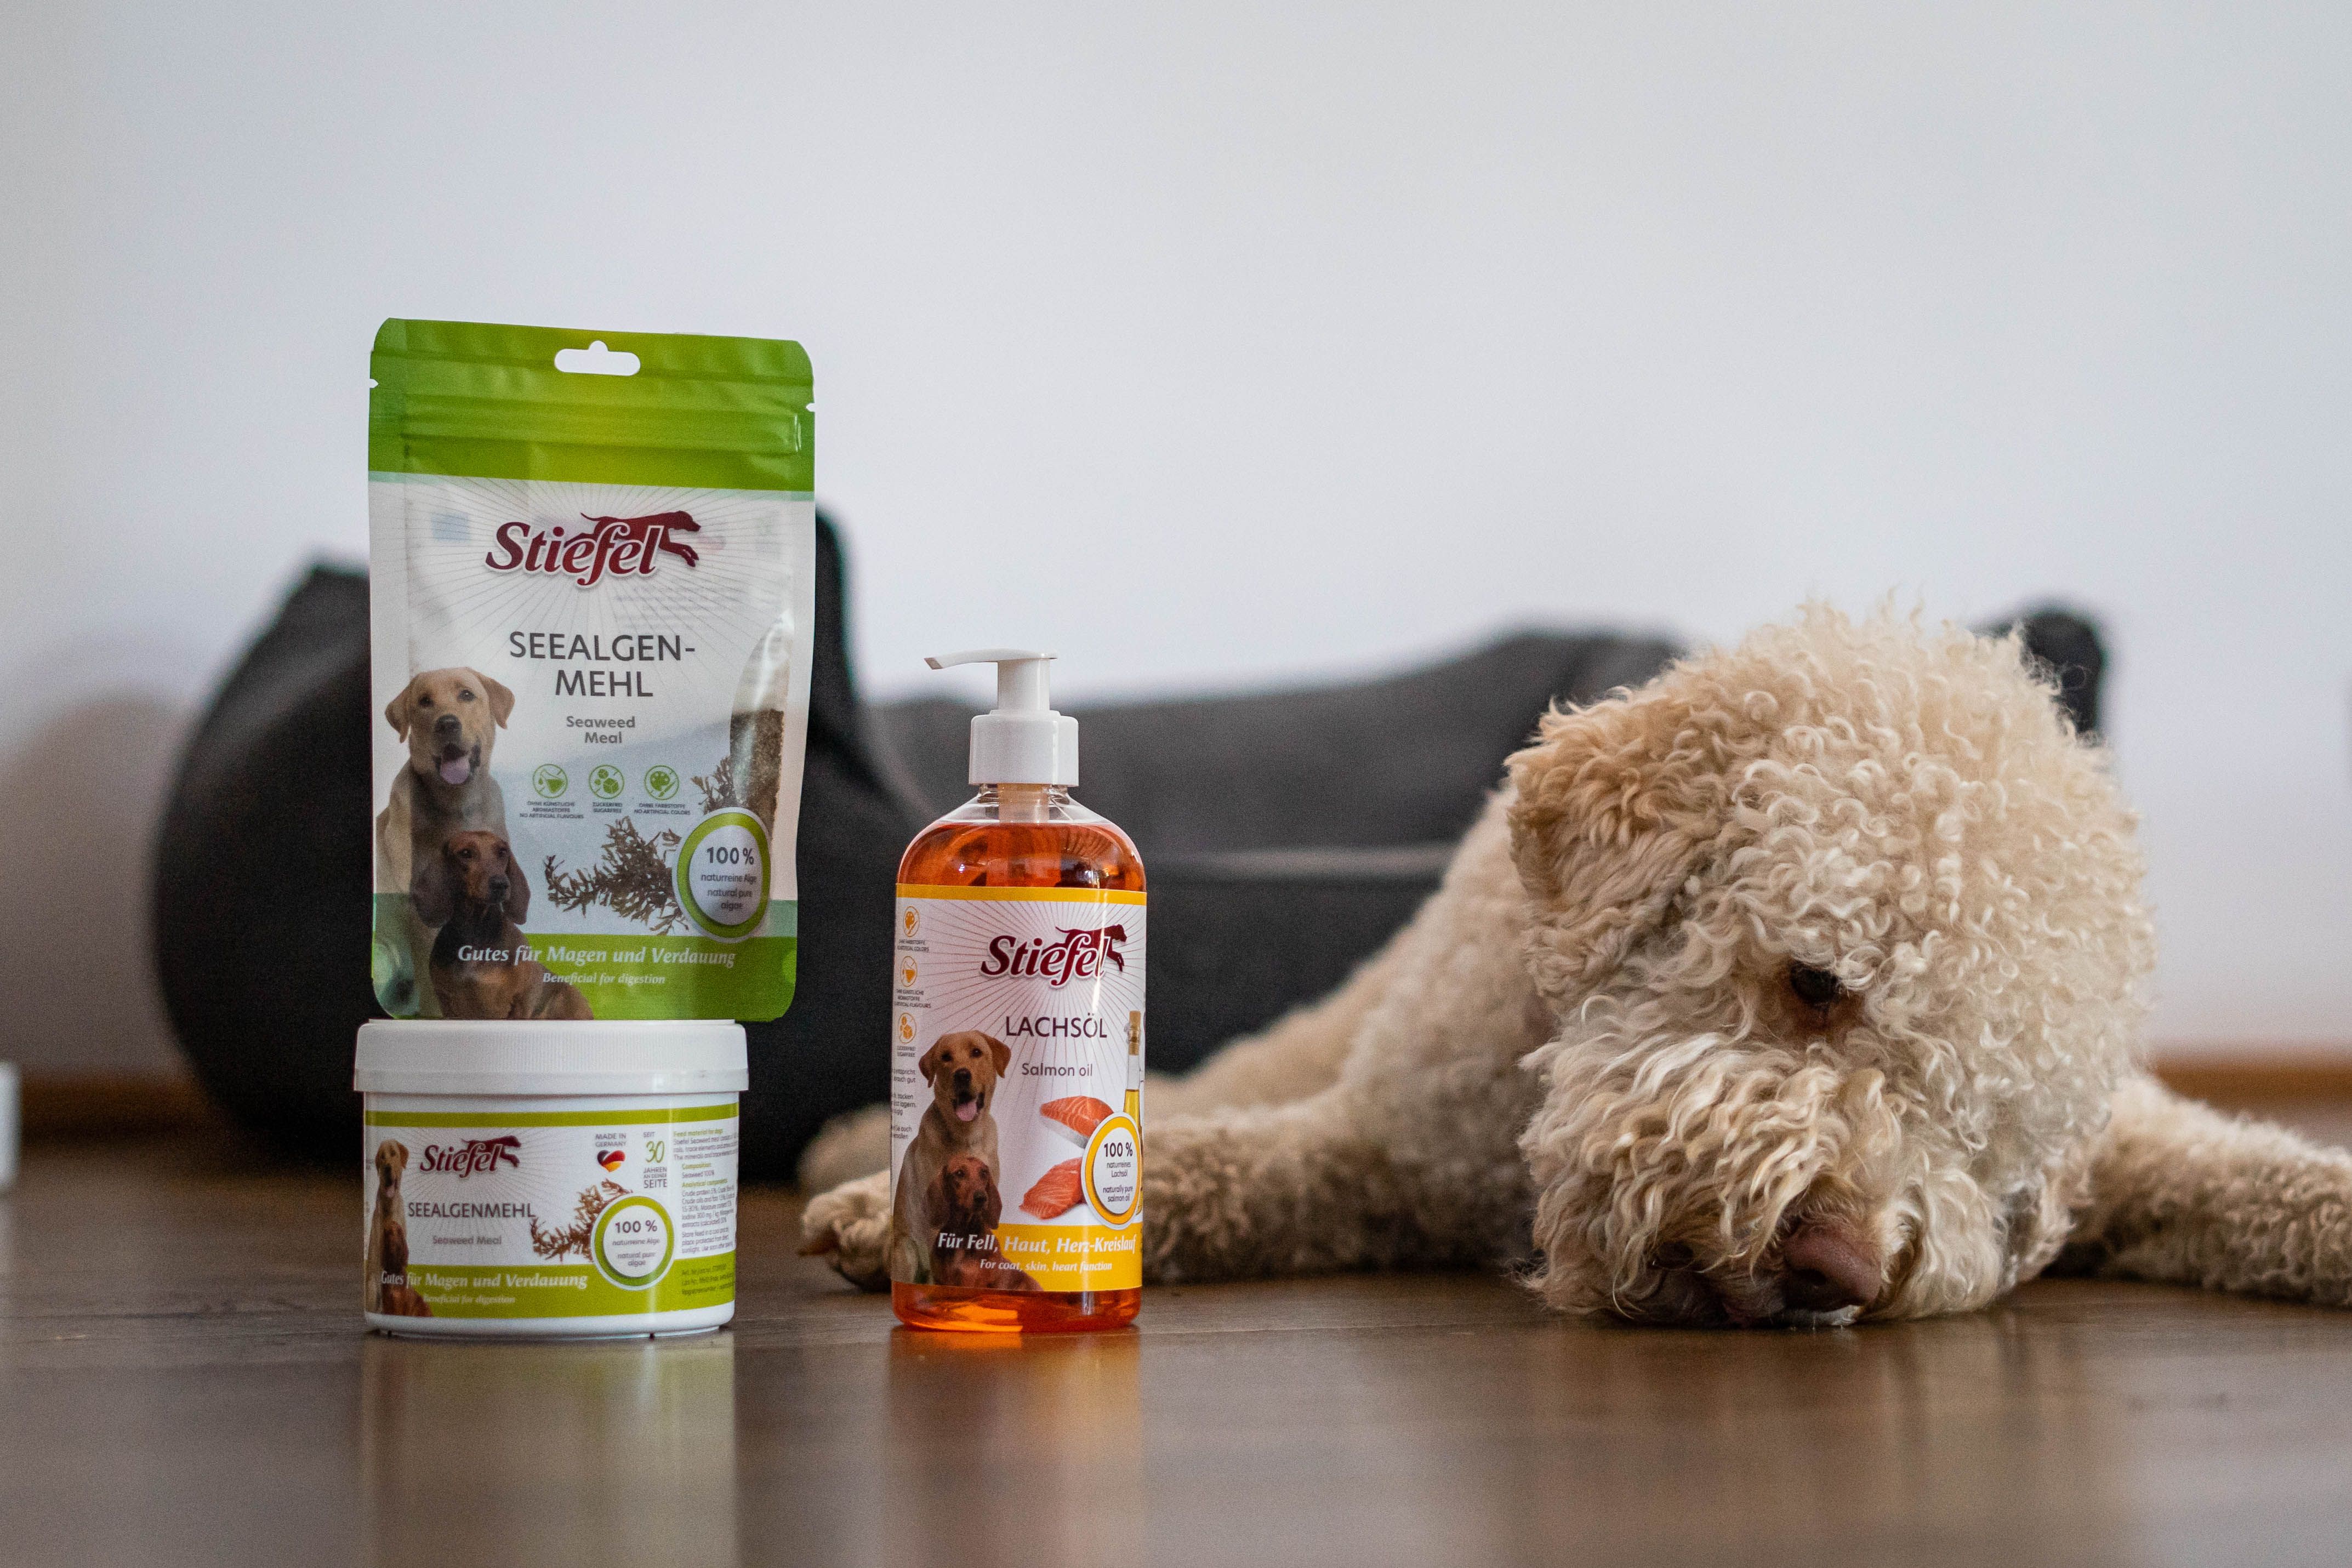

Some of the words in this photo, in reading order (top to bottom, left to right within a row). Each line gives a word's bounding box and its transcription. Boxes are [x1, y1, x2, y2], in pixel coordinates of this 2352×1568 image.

[486, 522, 663, 586] Stiefel
[510, 631, 696, 662] SEEALGEN-
[555, 670, 653, 697] MEHL
[566, 716, 636, 728] Seaweed
[584, 732, 622, 744] Meal
[707, 847, 739, 864] 100
[743, 848, 755, 865] %
[701, 874, 742, 882] naturreine
[743, 874, 757, 885] Alge
[707, 888, 737, 897] natural
[738, 890, 753, 899] pure
[721, 902, 743, 911] algae
[458, 945, 509, 961] Gutes
[514, 945, 543, 966] für
[546, 946, 607, 966] Magen
[613, 946, 646, 963] und
[652, 947, 737, 968] Verdauung
[981, 933, 1110, 985] Stiefel
[543, 972, 597, 985] Beneficial
[599, 973, 615, 985] for
[618, 973, 665, 987] digestion
[1006, 1013, 1107, 1037] LACHSÖL
[1022, 1063, 1075, 1076] Salmon
[1079, 1063, 1092, 1076] oil
[646, 1141, 665, 1163] 30
[1104, 1142, 1123, 1157] 100
[1125, 1142, 1133, 1157] %
[420, 1143, 503, 1178] Stiefel
[1111, 1170, 1127, 1178] Lachsöl
[643, 1179, 667, 1189] SEITE
[1103, 1185, 1124, 1194] naturally
[1125, 1185, 1133, 1194] pure
[1108, 1194, 1125, 1202] salmon
[408, 1202, 536, 1218] SEEALGENMEHL
[615, 1220, 641, 1233] 100
[645, 1219, 658, 1232] %
[433, 1235, 474, 1245] Seaweed
[477, 1236, 502, 1245] Meal
[647, 1238, 660, 1246] Alge
[938, 1233, 964, 1248] Für
[967, 1234, 998, 1252] Fell,
[1004, 1235, 1050, 1254] Haut,
[1056, 1235, 1137, 1255] Herz-Kreislauf
[628, 1259, 646, 1267] algae
[980, 1259, 995, 1270] For
[998, 1261, 1023, 1271] coat,
[1025, 1261, 1050, 1272] skin,
[1052, 1261, 1078, 1272] heart
[1079, 1262, 1112, 1273] function
[382, 1270, 403, 1285] Gutes
[406, 1272, 422, 1289] für
[425, 1273, 468, 1290] Magen
[473, 1273, 501, 1287] und
[505, 1274, 588, 1289] Verdauung
[462, 1294, 473, 1304] for
[476, 1295, 515, 1305] digestion
